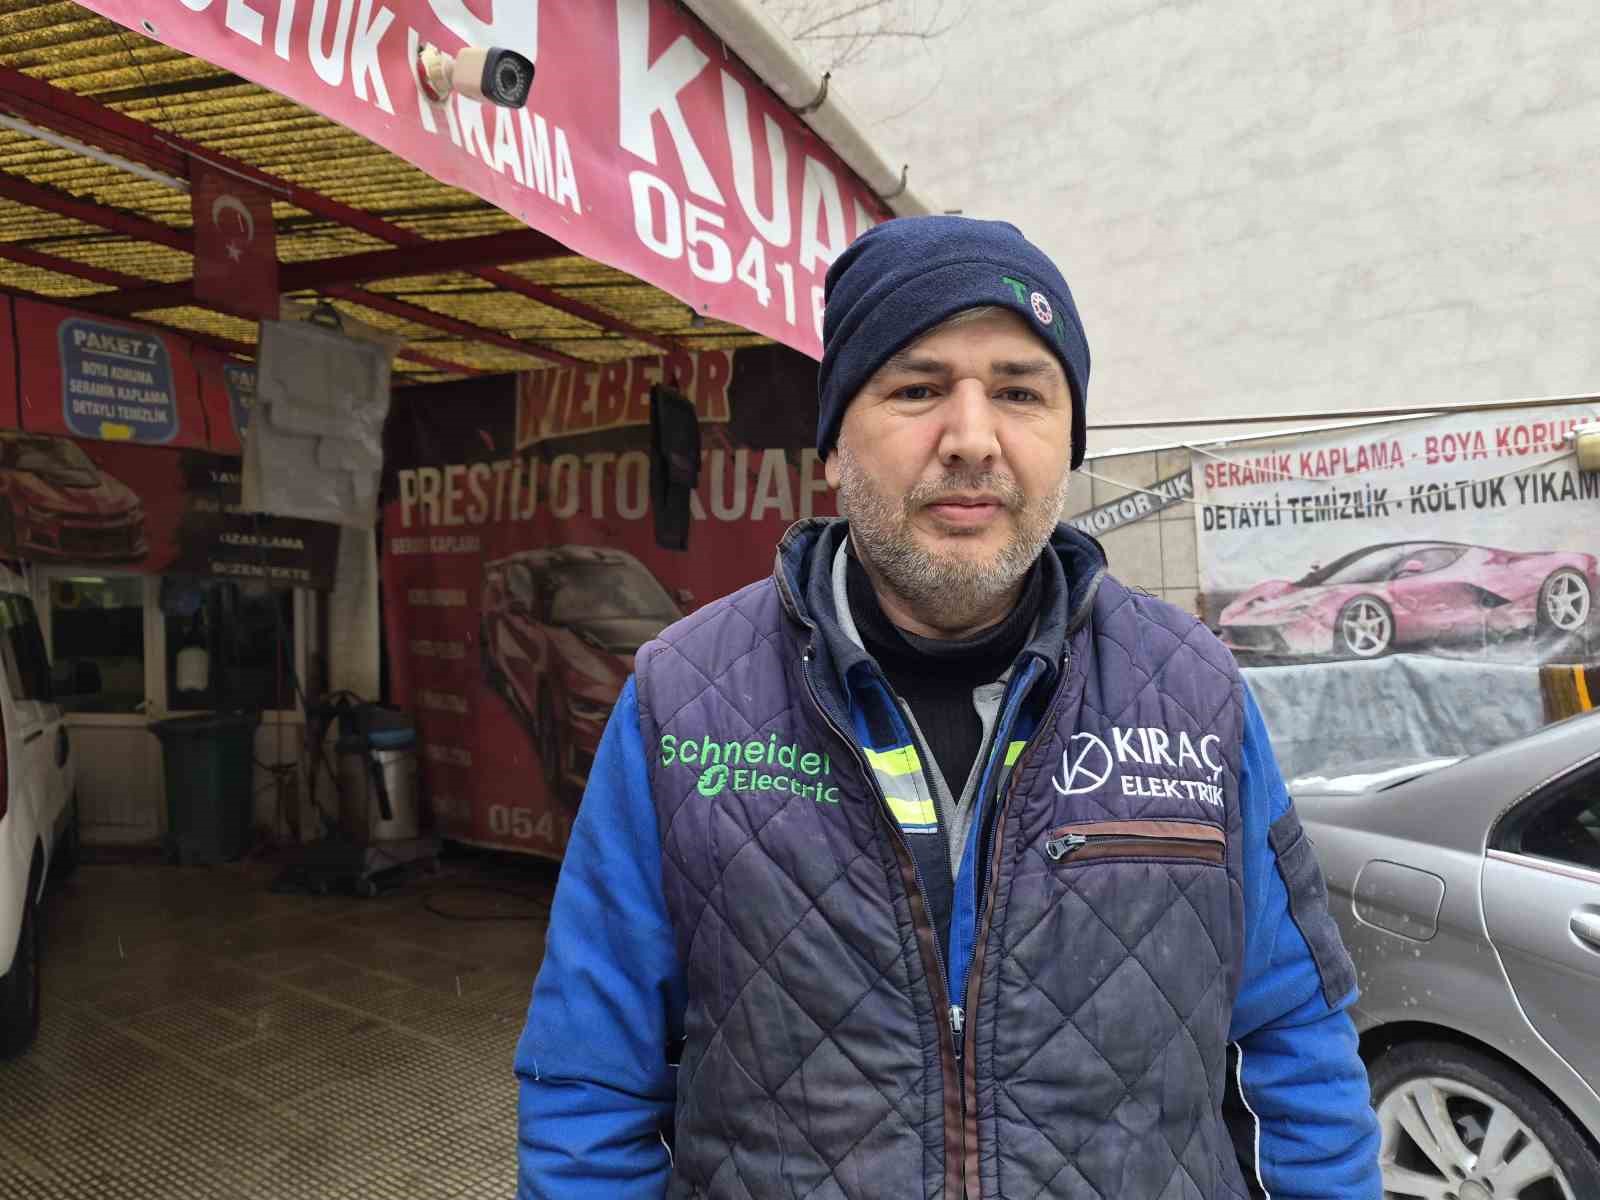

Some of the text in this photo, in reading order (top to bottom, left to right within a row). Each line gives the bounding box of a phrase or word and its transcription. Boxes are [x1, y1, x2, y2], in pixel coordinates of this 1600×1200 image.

[616, 0, 870, 275] KUA
[629, 170, 796, 326] 0541
[71, 328, 142, 355] PAKET
[1204, 449, 1293, 488] SERAMİK
[1300, 440, 1404, 477] KAPLAMA
[1425, 432, 1488, 464] BOYA
[396, 454, 540, 528] PRESTİJ
[548, 450, 652, 522] OTO
[1410, 476, 1507, 514] KOLTUK
[1112, 727, 1223, 782] KIRAÇ
[733, 769, 840, 803] Electric
[1121, 775, 1224, 807] ELEKTRİK
